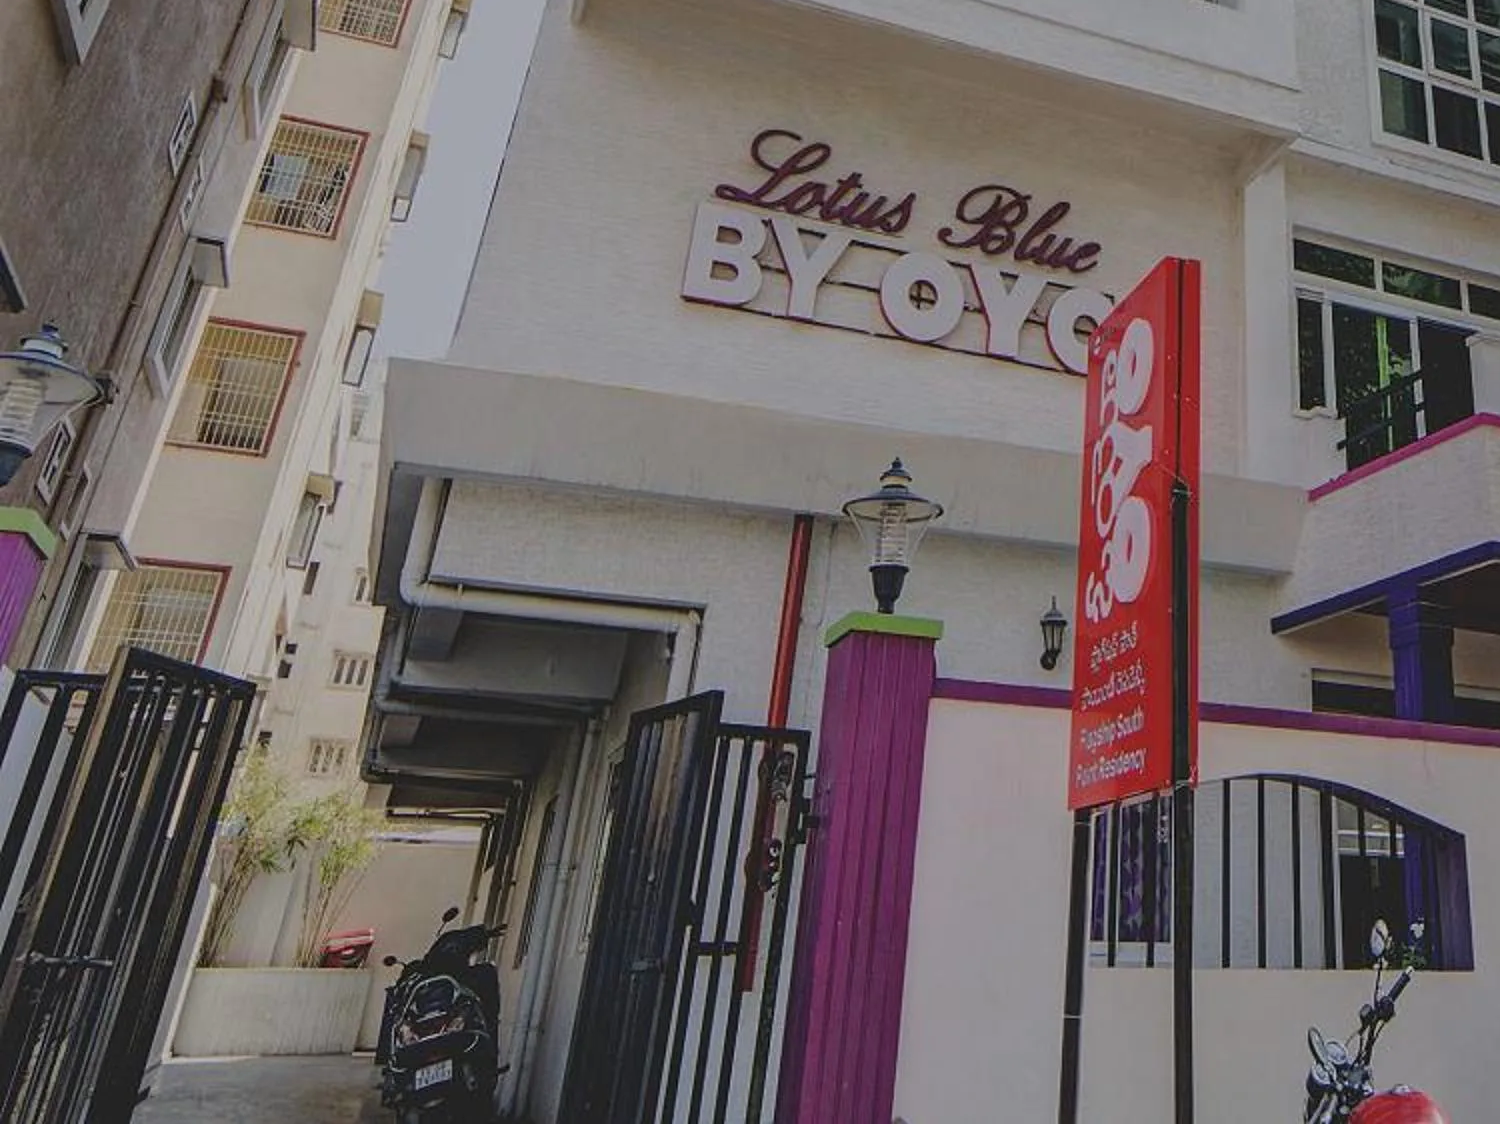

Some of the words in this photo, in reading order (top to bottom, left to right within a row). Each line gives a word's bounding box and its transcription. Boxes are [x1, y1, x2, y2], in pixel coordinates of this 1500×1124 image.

[681, 201, 851, 321] BY
[879, 250, 1114, 377] OYO
[714, 128, 918, 234] Lotus
[937, 183, 1103, 275] Blue
[1108, 316, 1155, 603] OYO
